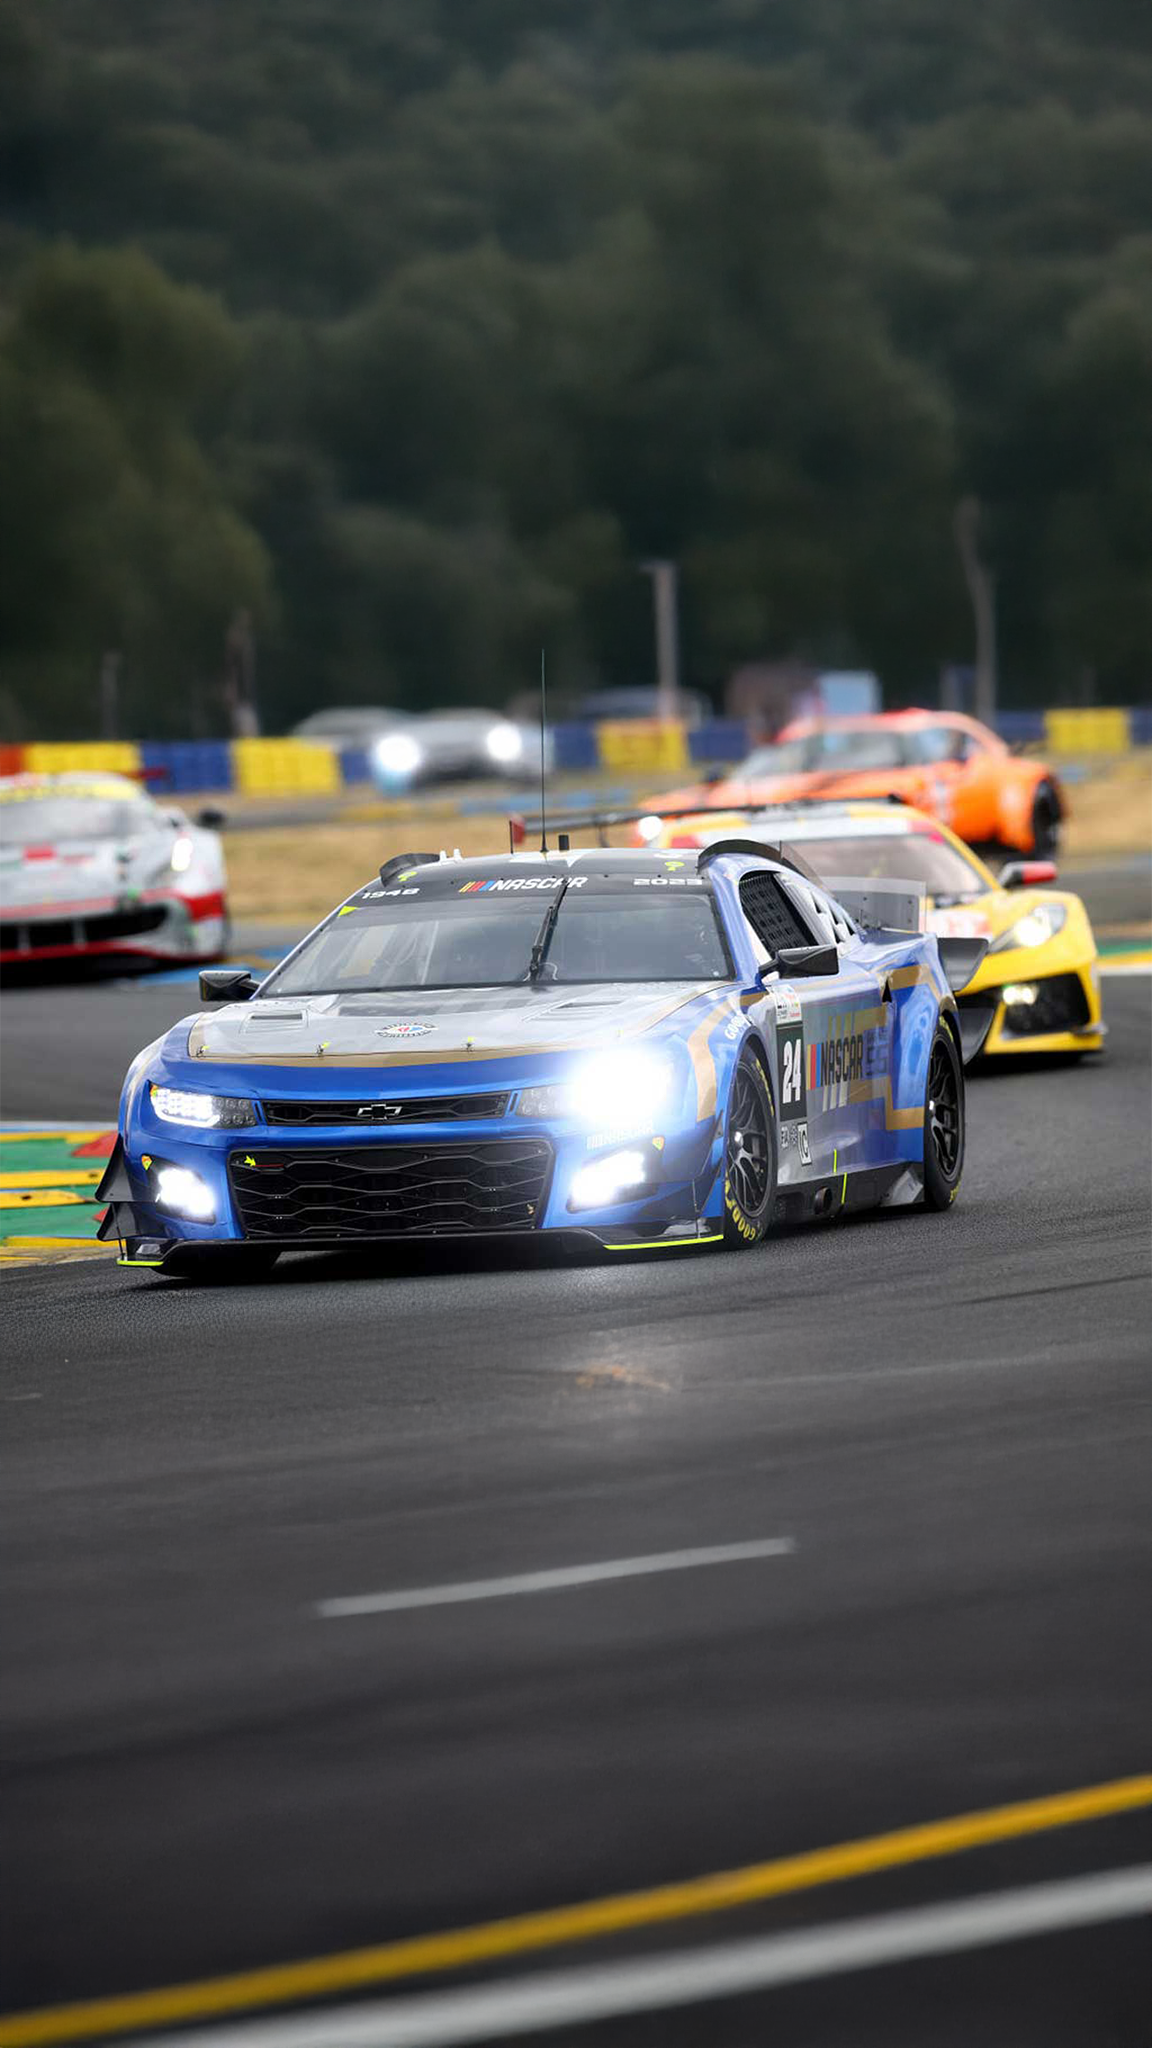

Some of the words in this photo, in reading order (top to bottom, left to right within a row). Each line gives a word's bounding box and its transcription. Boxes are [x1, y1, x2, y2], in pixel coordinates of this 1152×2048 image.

[362, 888, 420, 899] 1948
[782, 1038, 801, 1105] 24
[821, 1034, 863, 1087] NASCAR
